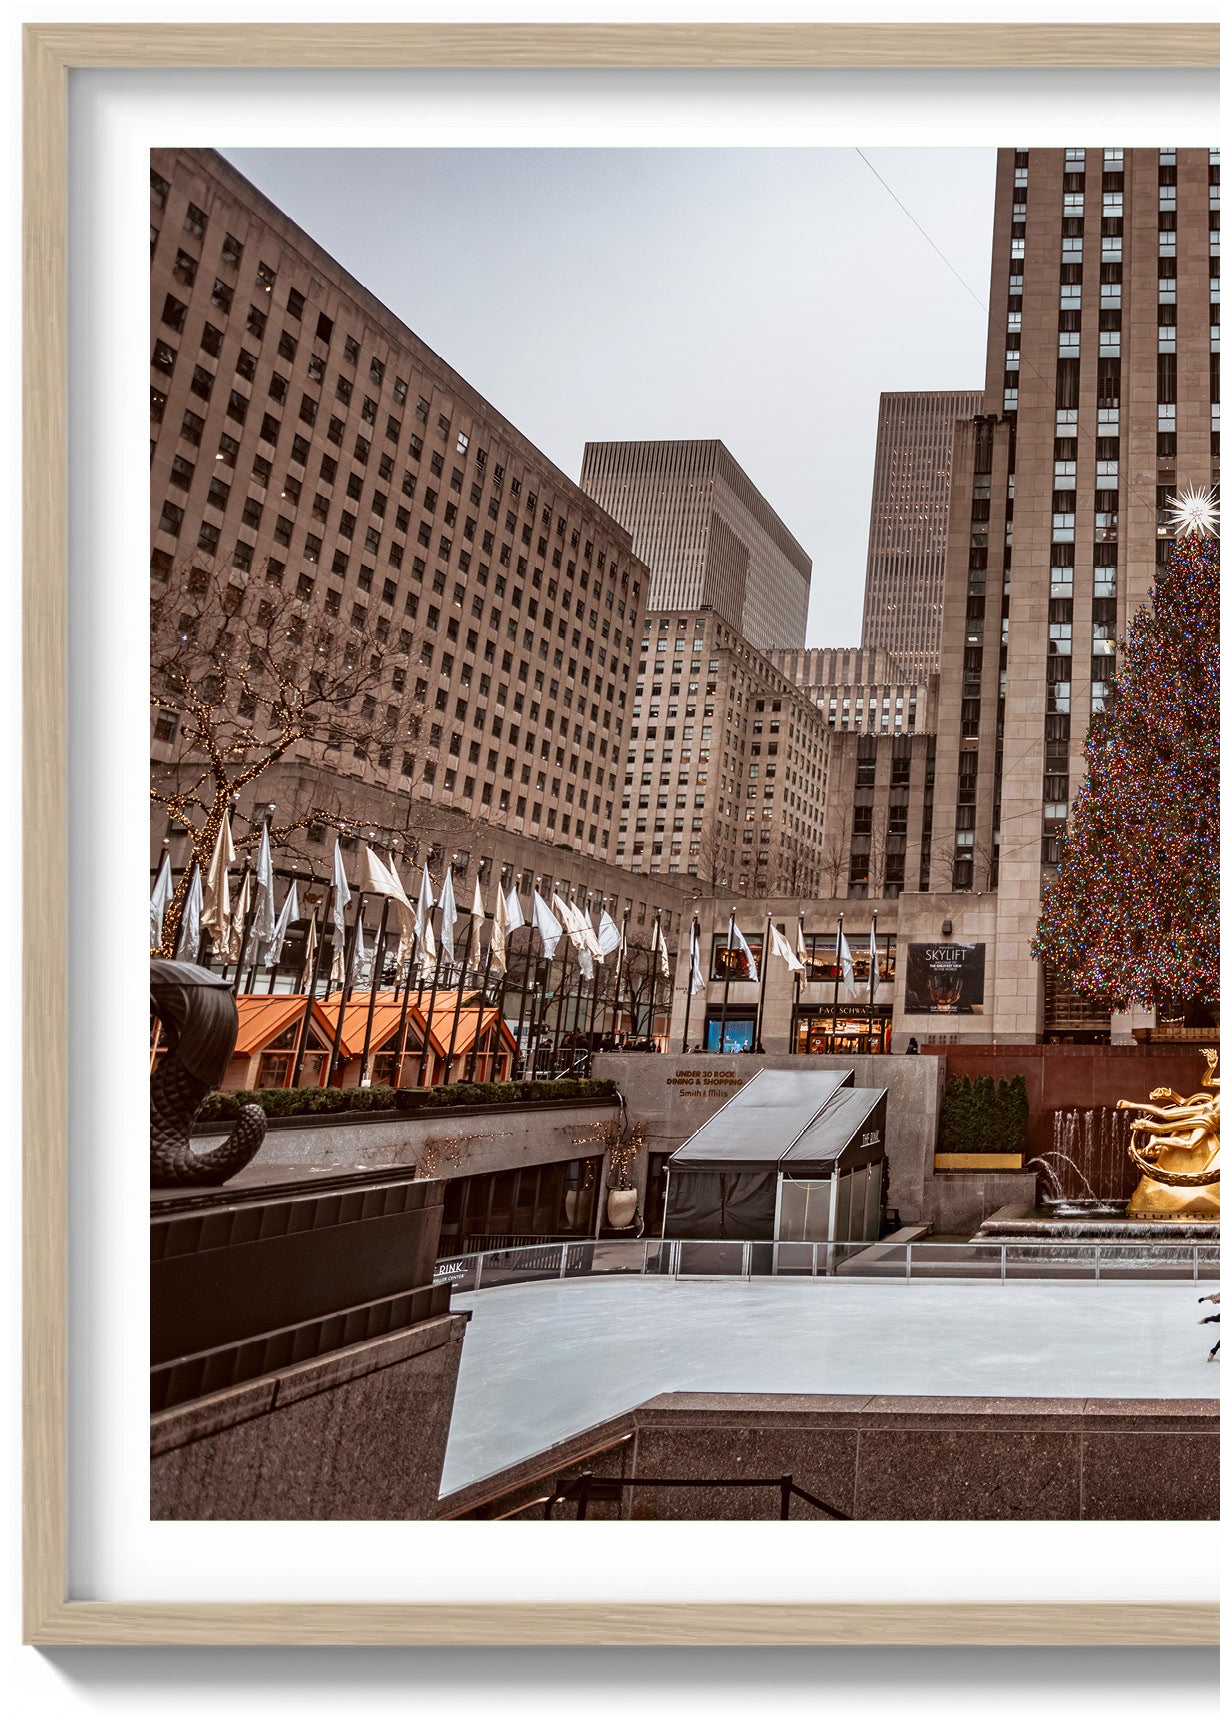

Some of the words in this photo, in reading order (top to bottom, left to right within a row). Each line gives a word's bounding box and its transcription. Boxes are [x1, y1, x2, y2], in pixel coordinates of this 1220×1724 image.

[925, 949, 967, 961] SKYLIFT
[676, 1070, 701, 1078] UNDER
[680, 1089, 702, 1097] Smith
[708, 1089, 728, 1097] Mills
[439, 1262, 463, 1275] RINK
